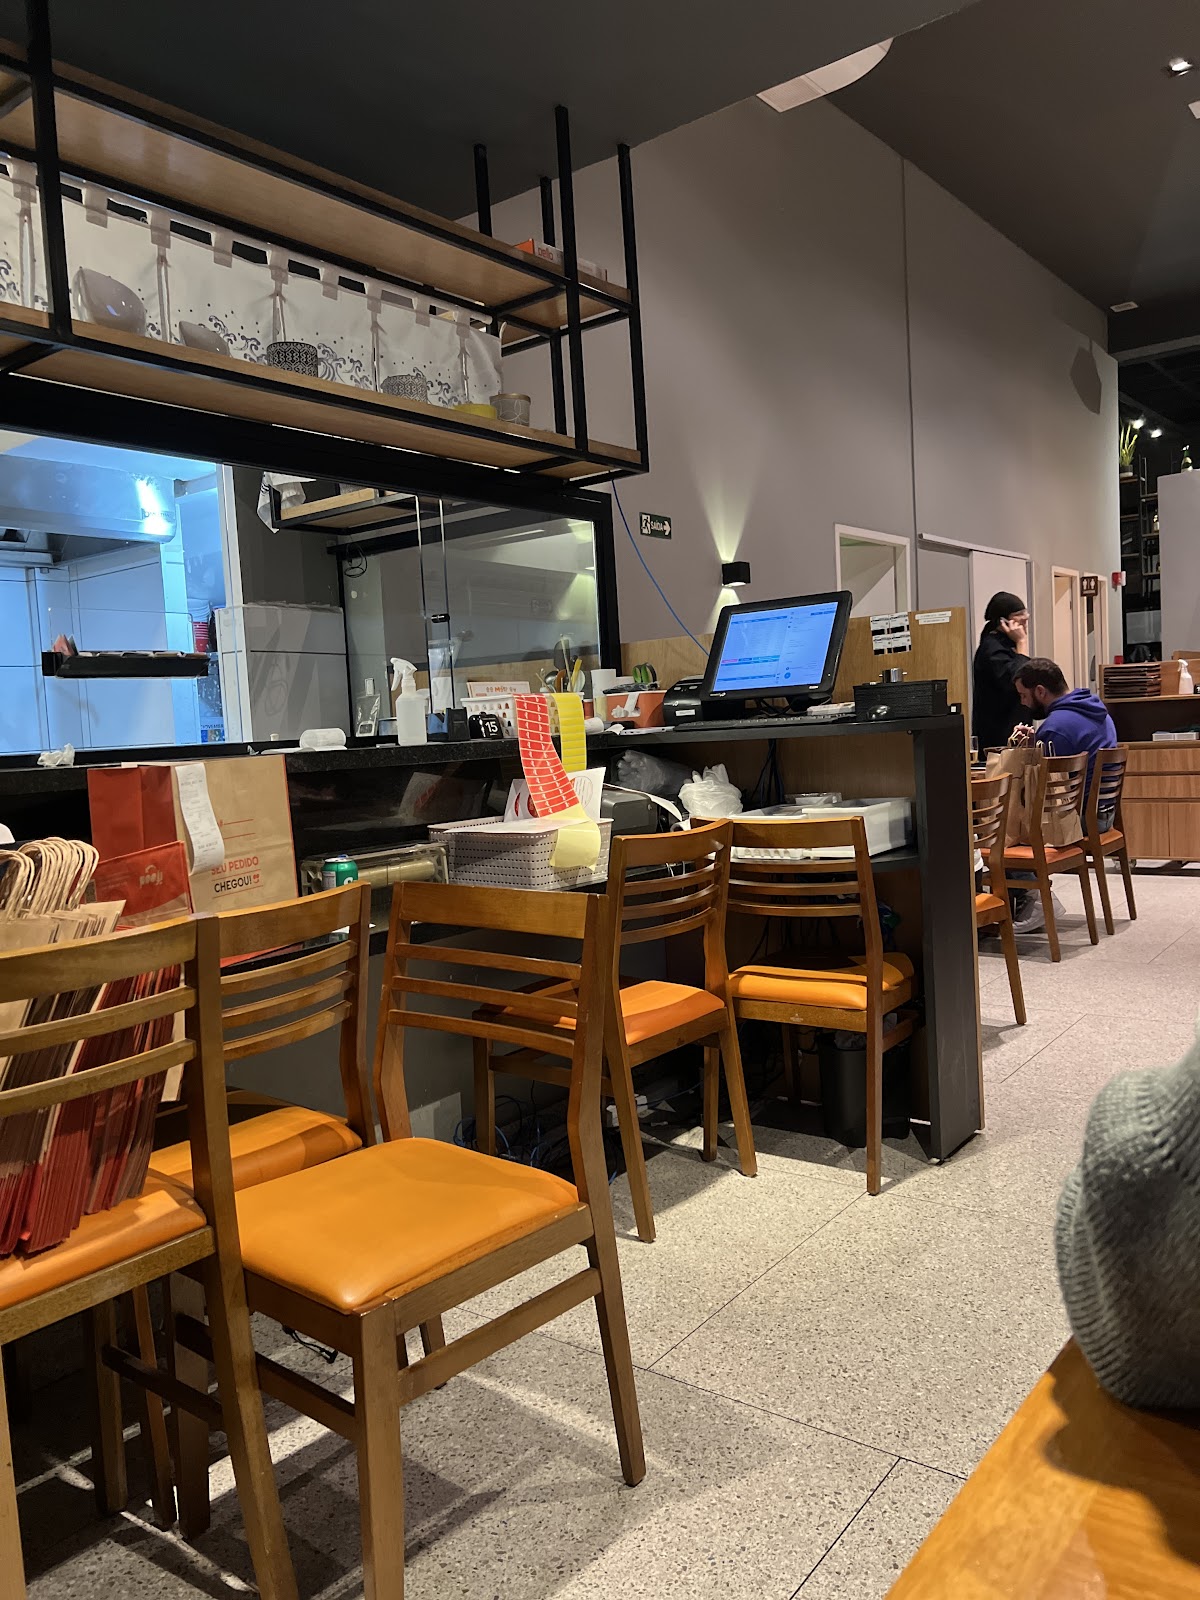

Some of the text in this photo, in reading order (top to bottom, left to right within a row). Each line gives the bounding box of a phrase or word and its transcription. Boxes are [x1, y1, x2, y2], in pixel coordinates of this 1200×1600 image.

[485, 721, 498, 733] 15
[228, 856, 259, 872] PEDIDO
[214, 876, 252, 893] CHEGOU!
